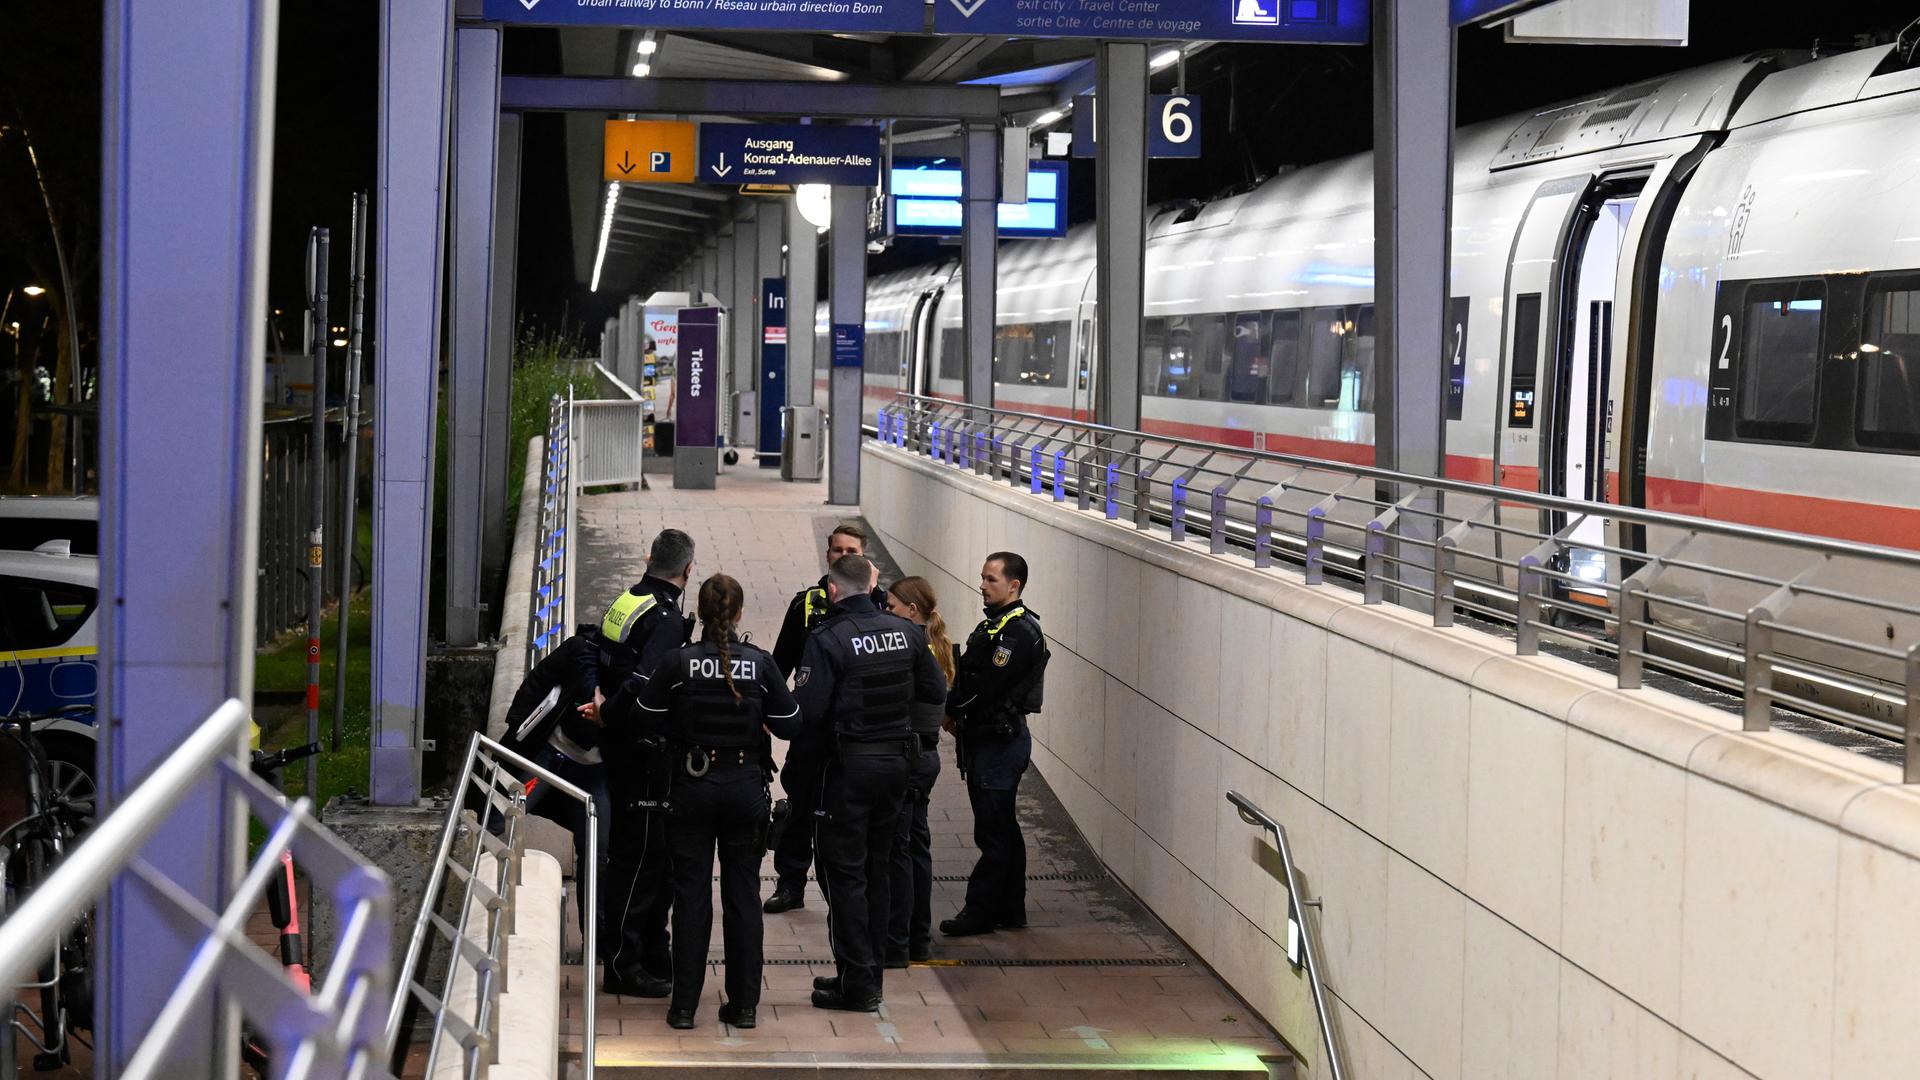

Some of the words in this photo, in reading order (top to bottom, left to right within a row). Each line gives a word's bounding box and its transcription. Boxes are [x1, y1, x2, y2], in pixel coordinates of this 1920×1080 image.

[615, 0, 656, 10] railway
[659, 0, 671, 8] to
[673, 0, 704, 9] Bonn
[714, 0, 757, 11] Réseau
[760, 1, 796, 12] urbain
[799, 1, 850, 13] direction
[852, 2, 883, 14] Bonn
[1016, 0, 1039, 10] exit
[1042, 0, 1066, 13] city
[1078, 0, 1115, 11] Travel
[1118, 0, 1161, 13] Center
[1016, 16, 1053, 28] sortie
[1093, 16, 1135, 29] Centre
[1137, 18, 1154, 30] de
[1157, 20, 1202, 33] voyage
[1161, 97, 1193, 144] 6
[744, 138, 794, 152] Ausgang
[651, 152, 665, 172] P
[743, 153, 872, 167] Konrad-Adenauer-Allee
[769, 292, 787, 309] In
[1453, 322, 1463, 366] 2
[1718, 313, 1732, 370] 2
[690, 348, 704, 398] Tickets
[850, 631, 909, 656] POLIZEI
[689, 658, 756, 680] POLZEI
